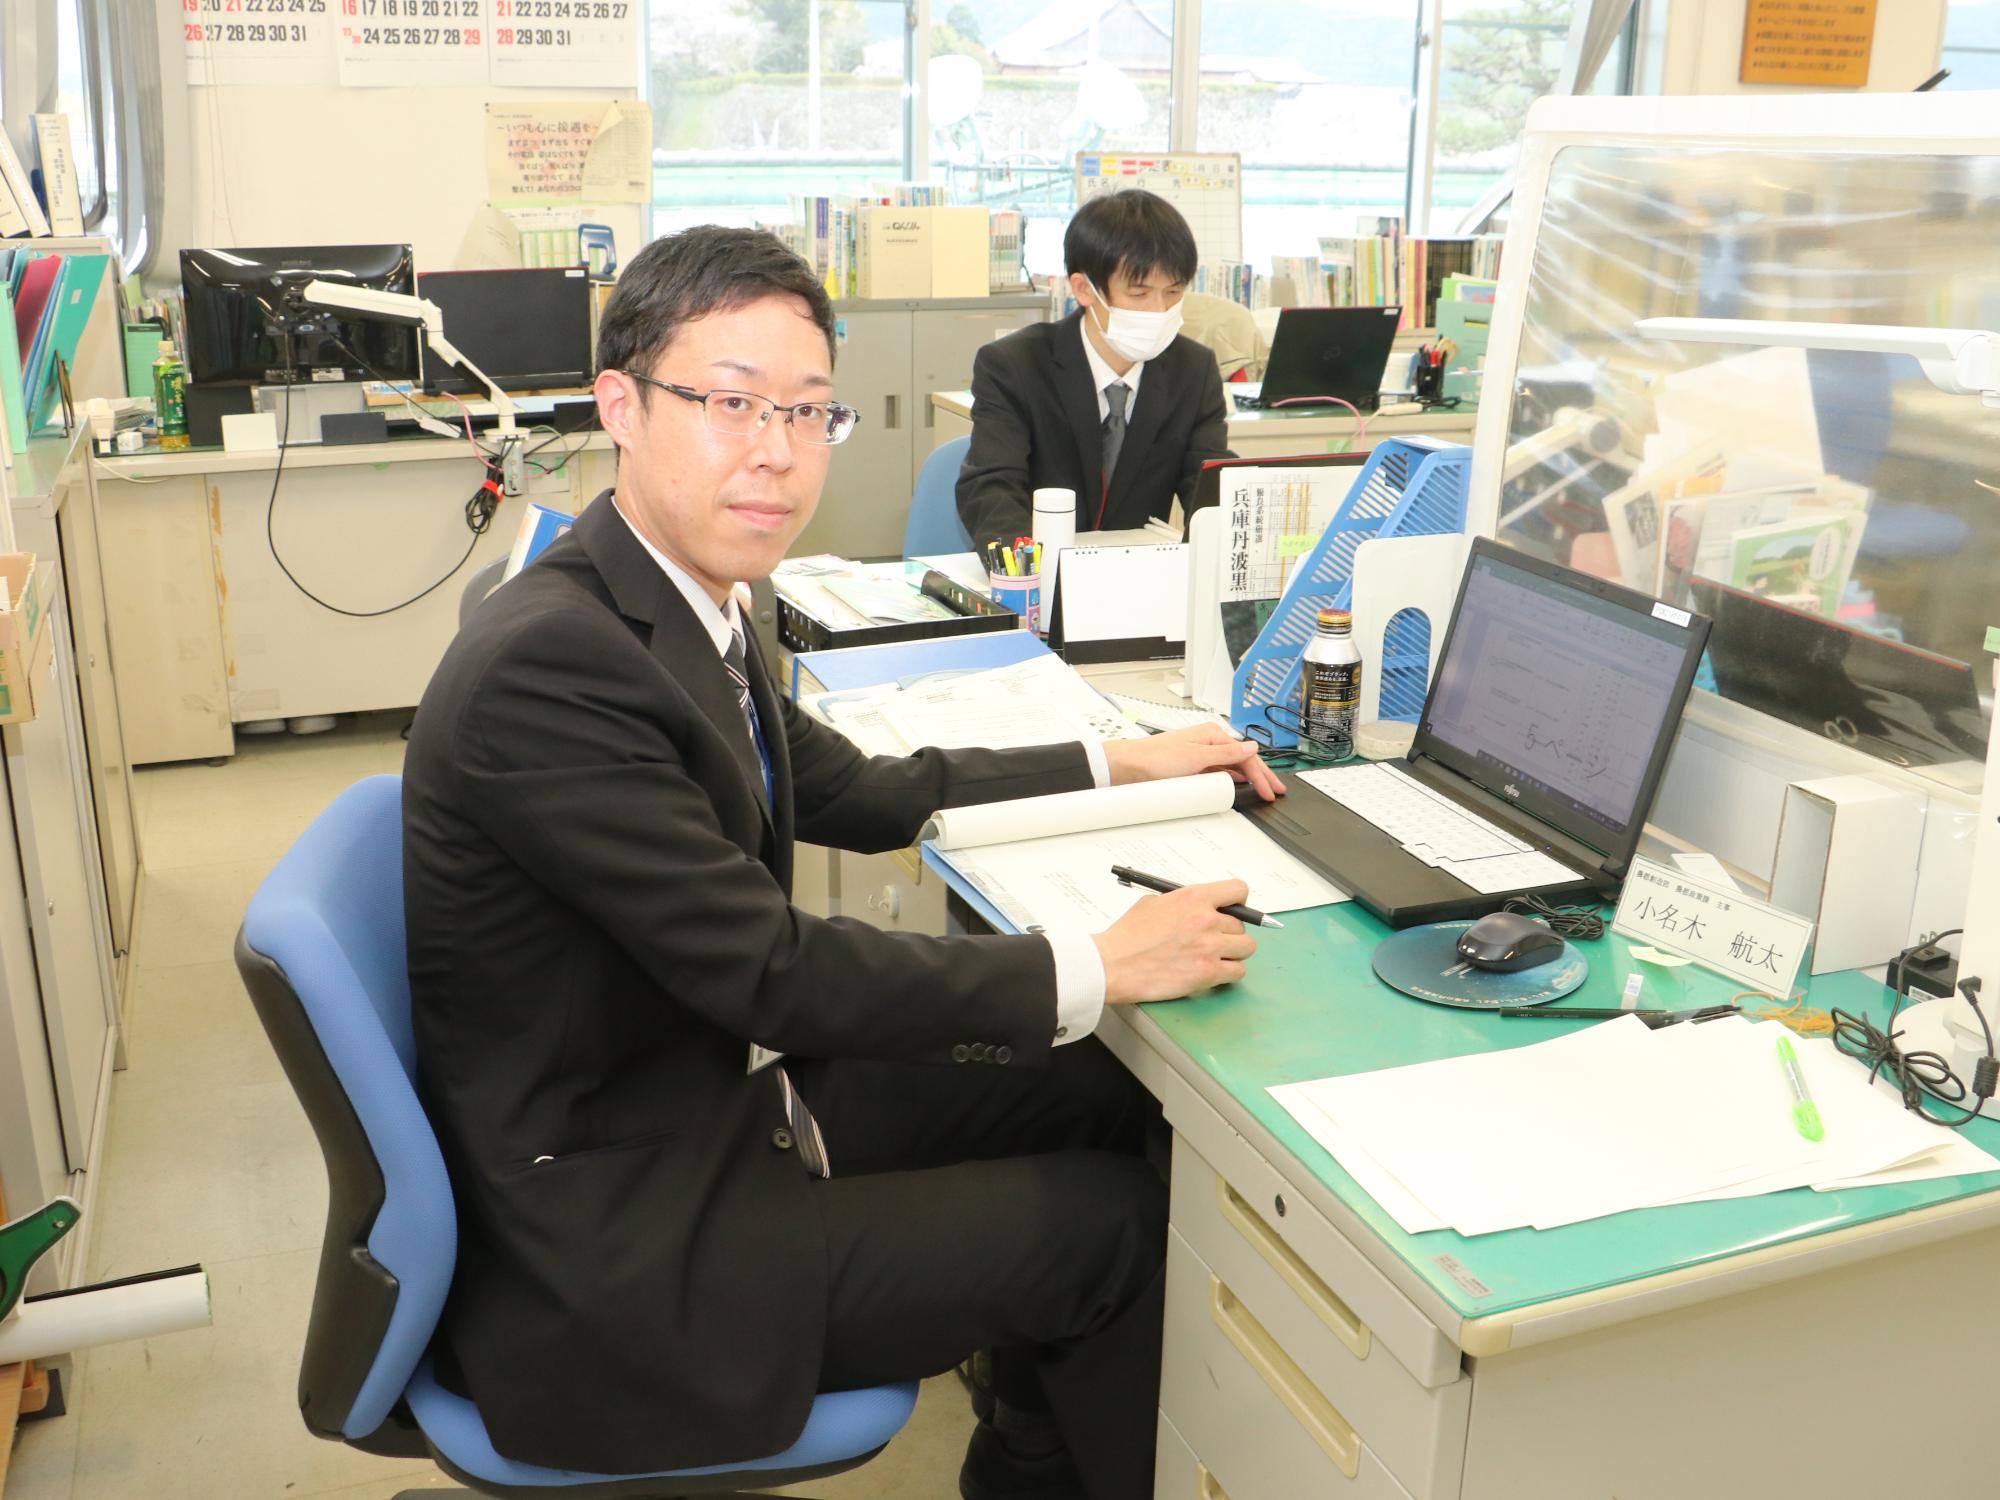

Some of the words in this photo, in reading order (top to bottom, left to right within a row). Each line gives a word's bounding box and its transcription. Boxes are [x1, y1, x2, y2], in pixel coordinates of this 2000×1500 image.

[182, 0, 198, 12] 19
[203, 0, 221, 12] 20
[226, 0, 242, 12] 21
[245, 0, 264, 12] 22
[267, 0, 284, 12] 23
[287, 0, 305, 12] 24
[309, 0, 326, 12] 25
[342, 0, 357, 16] 16
[362, 0, 377, 16] 17
[383, 0, 398, 16] 18
[403, 0, 418, 16] 19
[422, 1, 439, 16] 20
[443, 1, 458, 17] 21
[462, 1, 479, 17] 22
[497, 1, 512, 17] 21
[515, 1, 532, 17] 22
[535, 1, 552, 18] 23
[554, 2, 571, 18] 24
[574, 2, 590, 18] 25
[593, 3, 610, 19] 26
[612, 3, 628, 19] 27
[184, 24, 202, 42] 26
[226, 25, 245, 42] 28
[248, 25, 266, 42] 29
[268, 25, 287, 42] 30
[291, 25, 307, 42] 31
[363, 28, 380, 44] 24
[383, 29, 401, 45] 25
[403, 29, 421, 45] 26
[423, 29, 440, 45] 27
[443, 29, 461, 45] 28
[463, 29, 481, 45] 29
[497, 29, 513, 45] 28
[516, 29, 533, 45] 29
[536, 29, 553, 45] 30
[556, 30, 571, 46] 31
[1230, 488, 1250, 592] 兵庫丹波黒
[1633, 896, 1707, 940] 小名木
[1727, 931, 1784, 974] 航太
